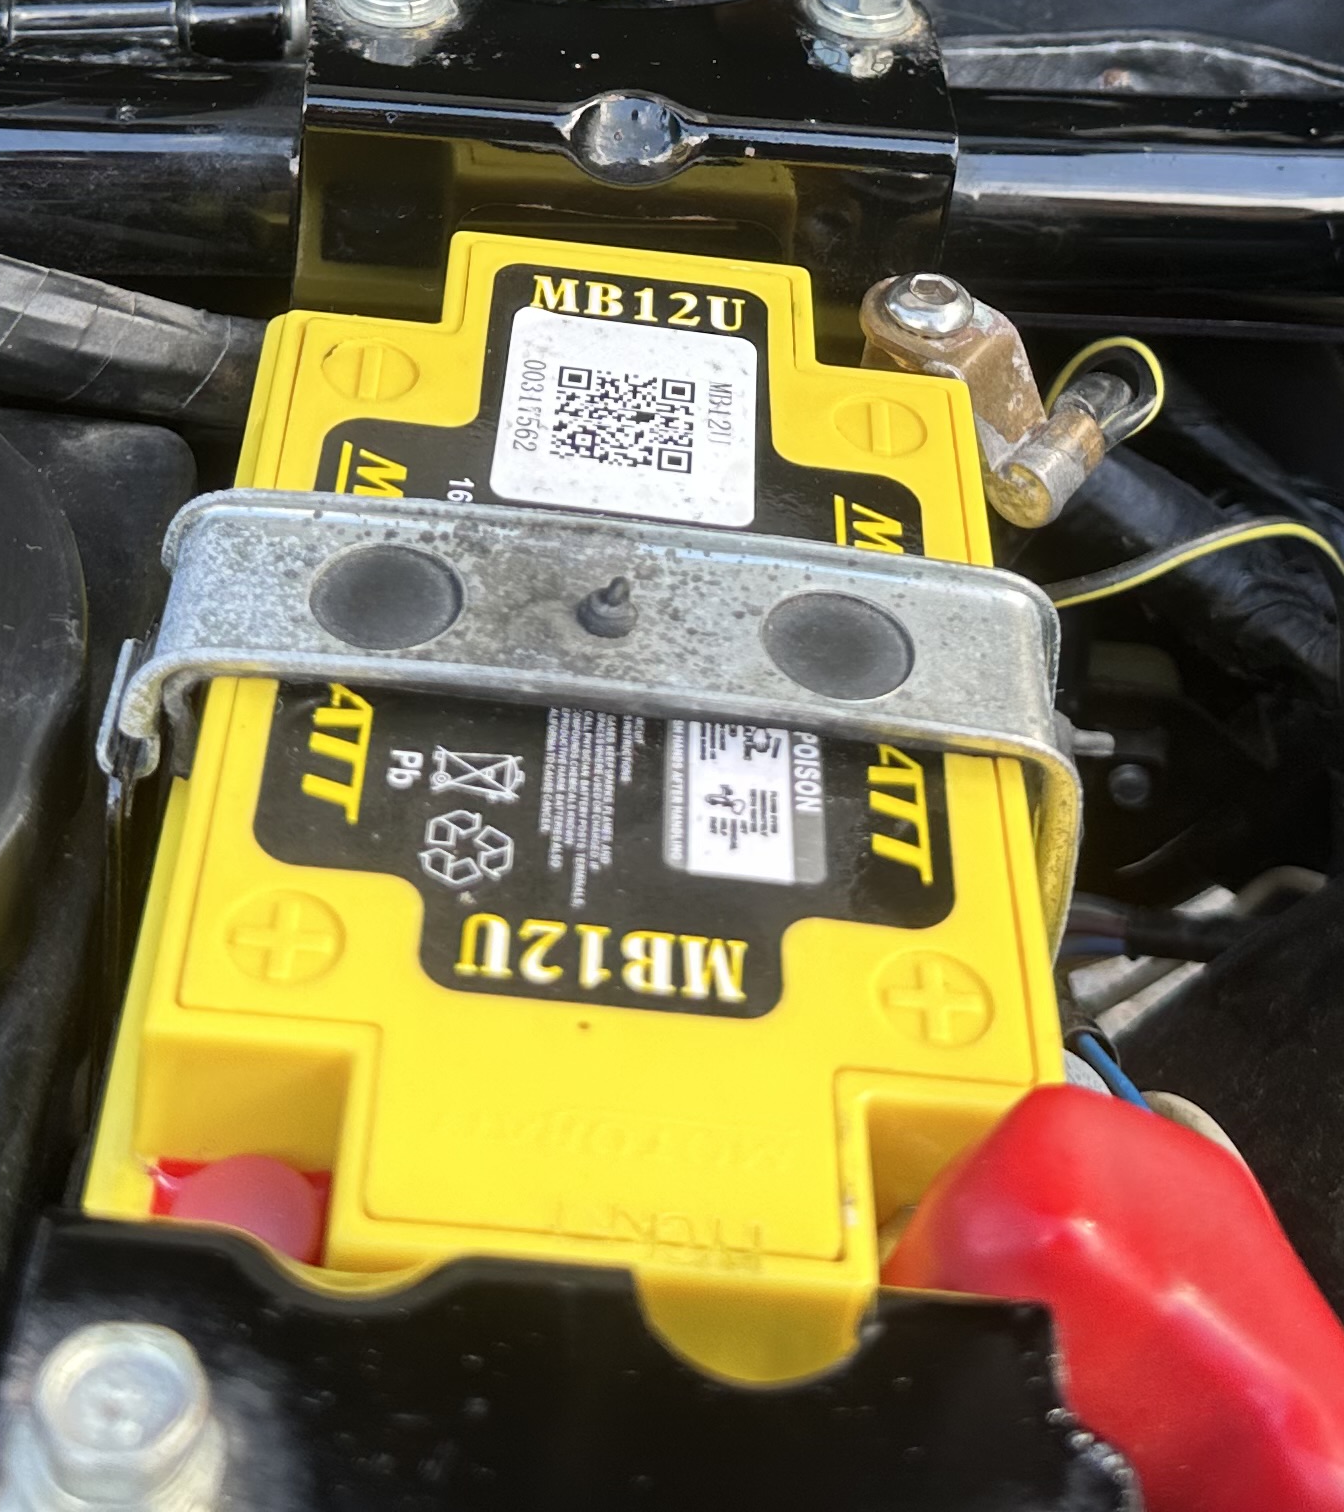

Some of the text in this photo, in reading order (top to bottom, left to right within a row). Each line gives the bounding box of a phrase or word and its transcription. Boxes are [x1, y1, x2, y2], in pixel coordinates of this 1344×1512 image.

[530, 275, 745, 331] MB12U
[513, 360, 546, 451] 00317562
[708, 382, 732, 445] MB12U
[387, 748, 423, 789] Pb
[793, 731, 823, 812] POISON
[453, 913, 749, 1003] MB12U
